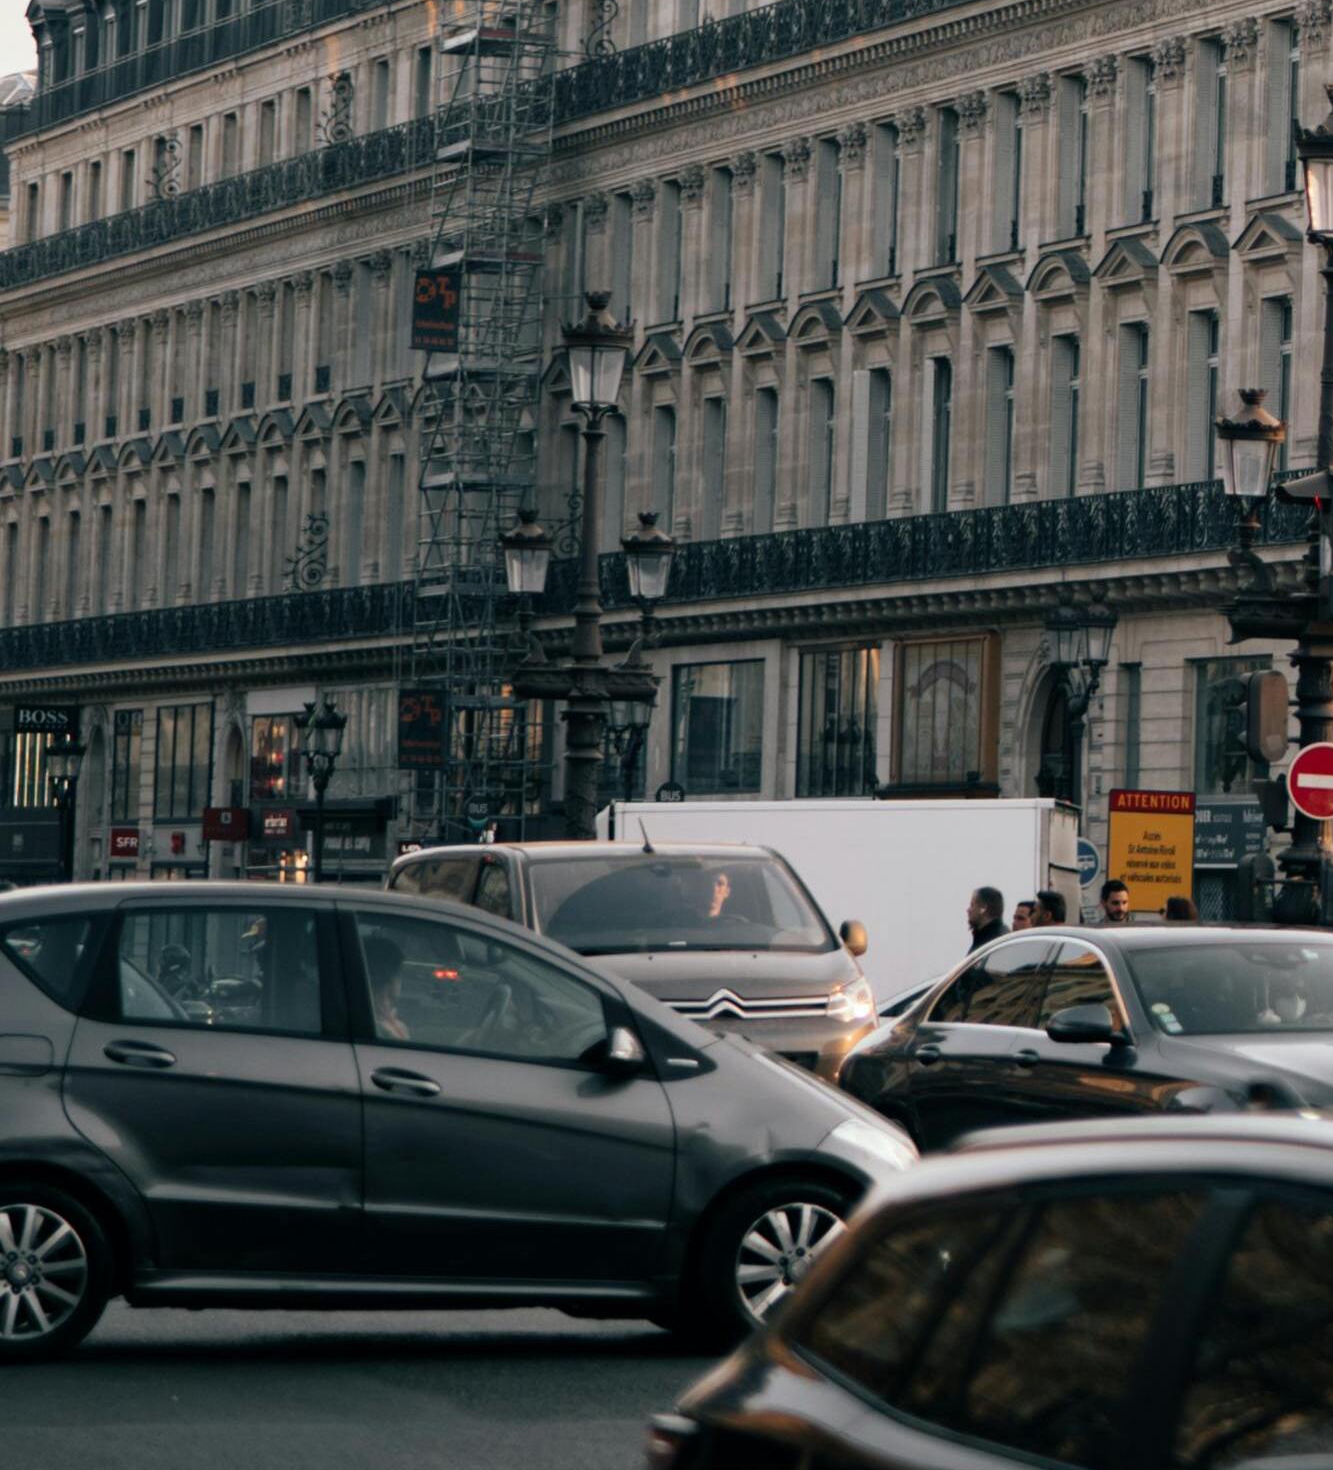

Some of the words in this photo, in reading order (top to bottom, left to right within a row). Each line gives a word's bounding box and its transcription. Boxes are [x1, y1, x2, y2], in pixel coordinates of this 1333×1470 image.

[19, 709, 69, 724] BOSS
[1118, 794, 1190, 809] ATTENTION
[468, 803, 489, 814] BUS
[116, 837, 138, 848] SFR
